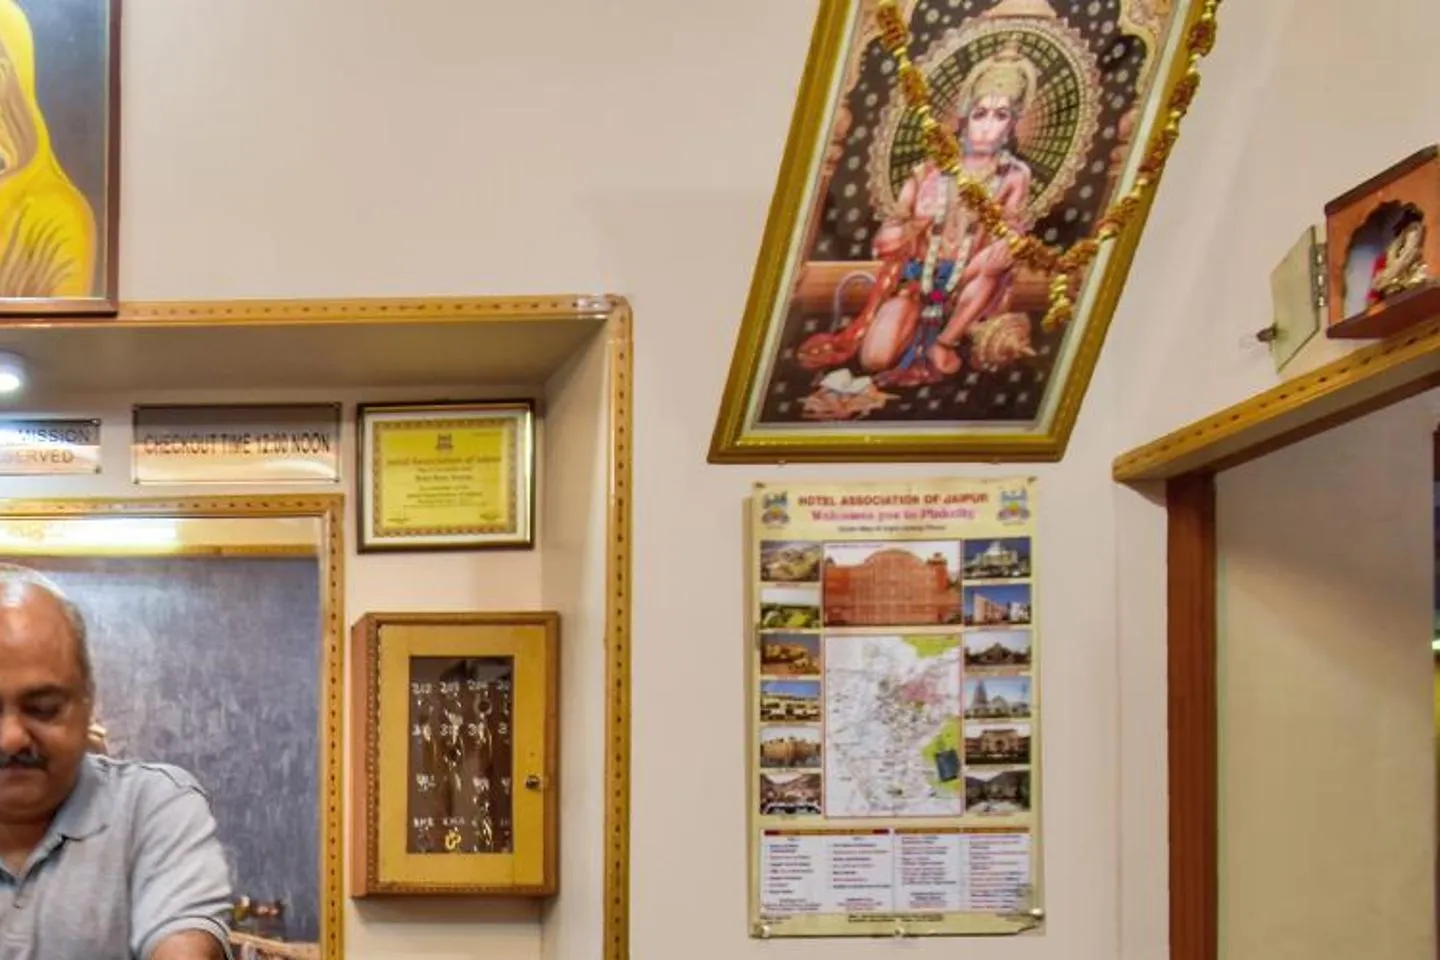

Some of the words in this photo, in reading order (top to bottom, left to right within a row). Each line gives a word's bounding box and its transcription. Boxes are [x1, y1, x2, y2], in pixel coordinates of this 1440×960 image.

[144, 434, 216, 454] CHECKOUT
[221, 433, 251, 454] TIME
[291, 432, 330, 453] NOON
[798, 495, 835, 507] HOTEL
[841, 494, 920, 506] ASSOCIATION
[925, 493, 939, 505] OF
